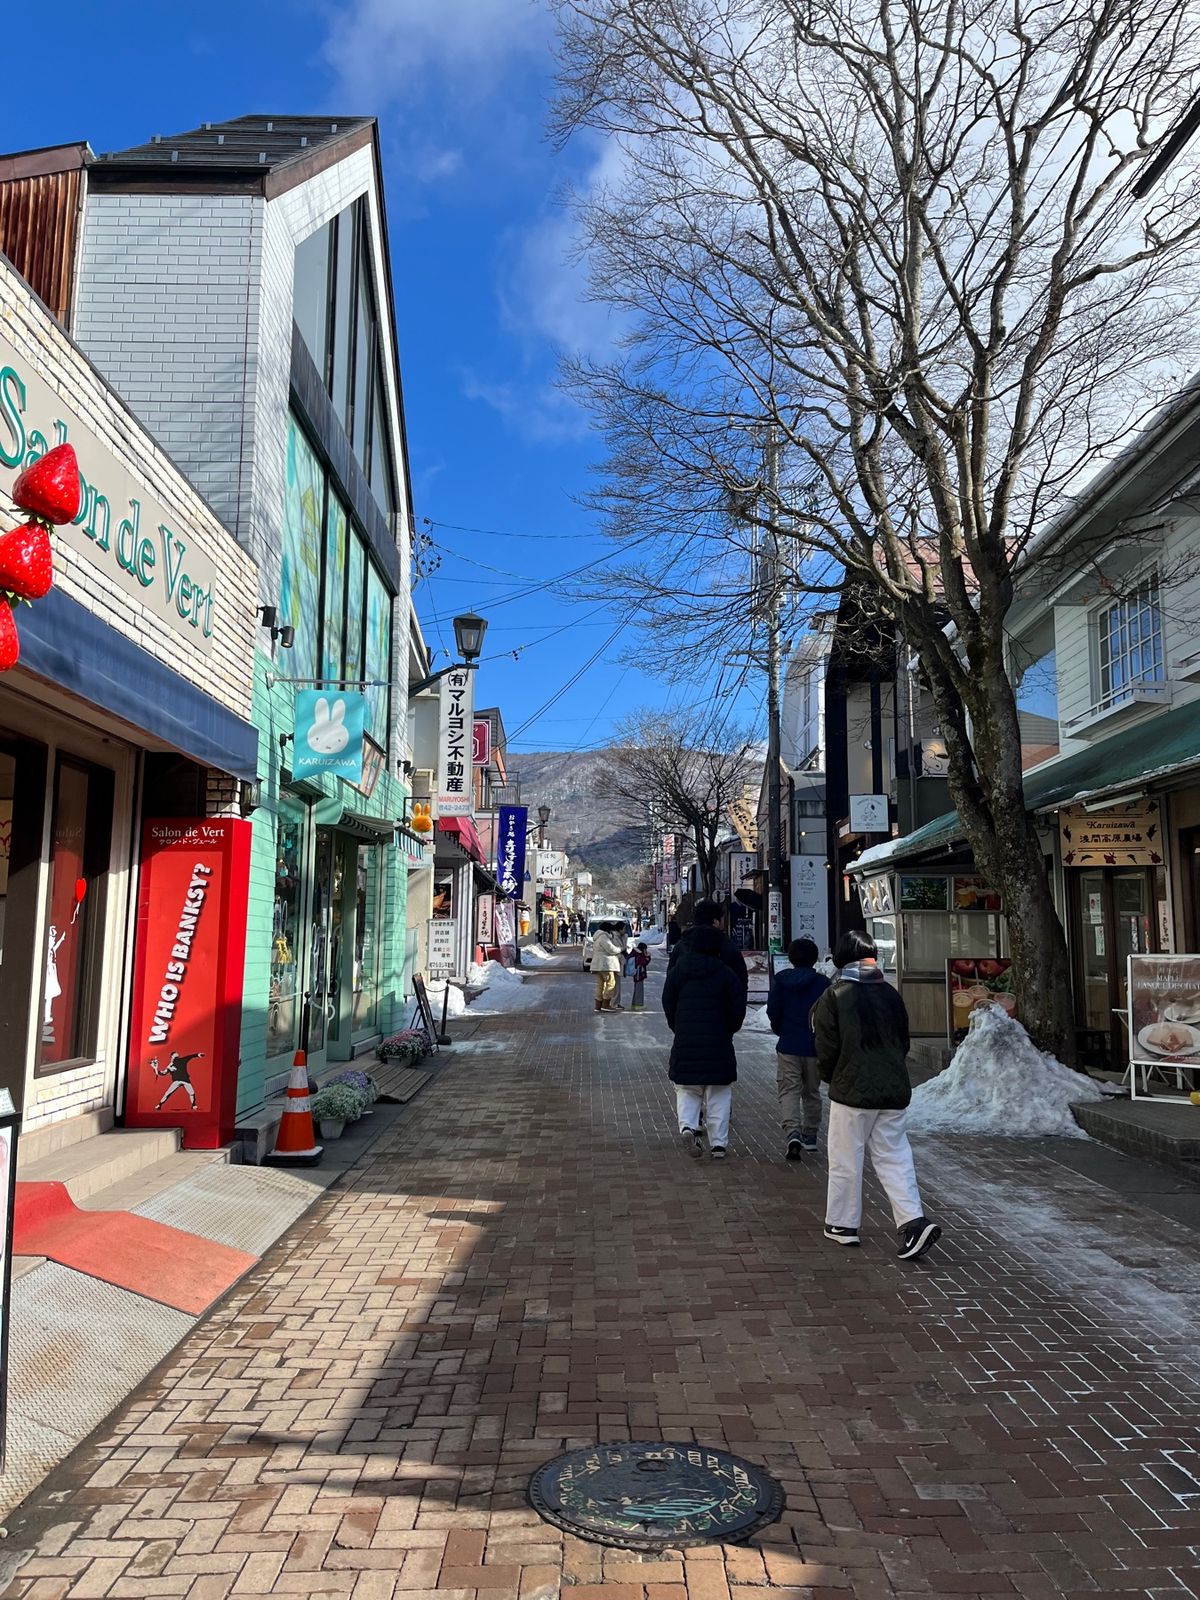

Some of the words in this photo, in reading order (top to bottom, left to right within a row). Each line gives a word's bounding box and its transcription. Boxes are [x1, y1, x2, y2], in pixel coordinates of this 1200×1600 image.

[115, 498, 156, 588] de
[158, 523, 214, 638] Vert
[298, 757, 357, 767] KARUIZAWA
[151, 826, 182, 837] Salon
[185, 826, 198, 837] de
[201, 826, 225, 837] Vert
[1086, 820, 1136, 830] Karuizawa
[171, 862, 213, 961] BANKSY?
[165, 958, 186, 984] IS
[148, 986, 178, 1044] WHO
